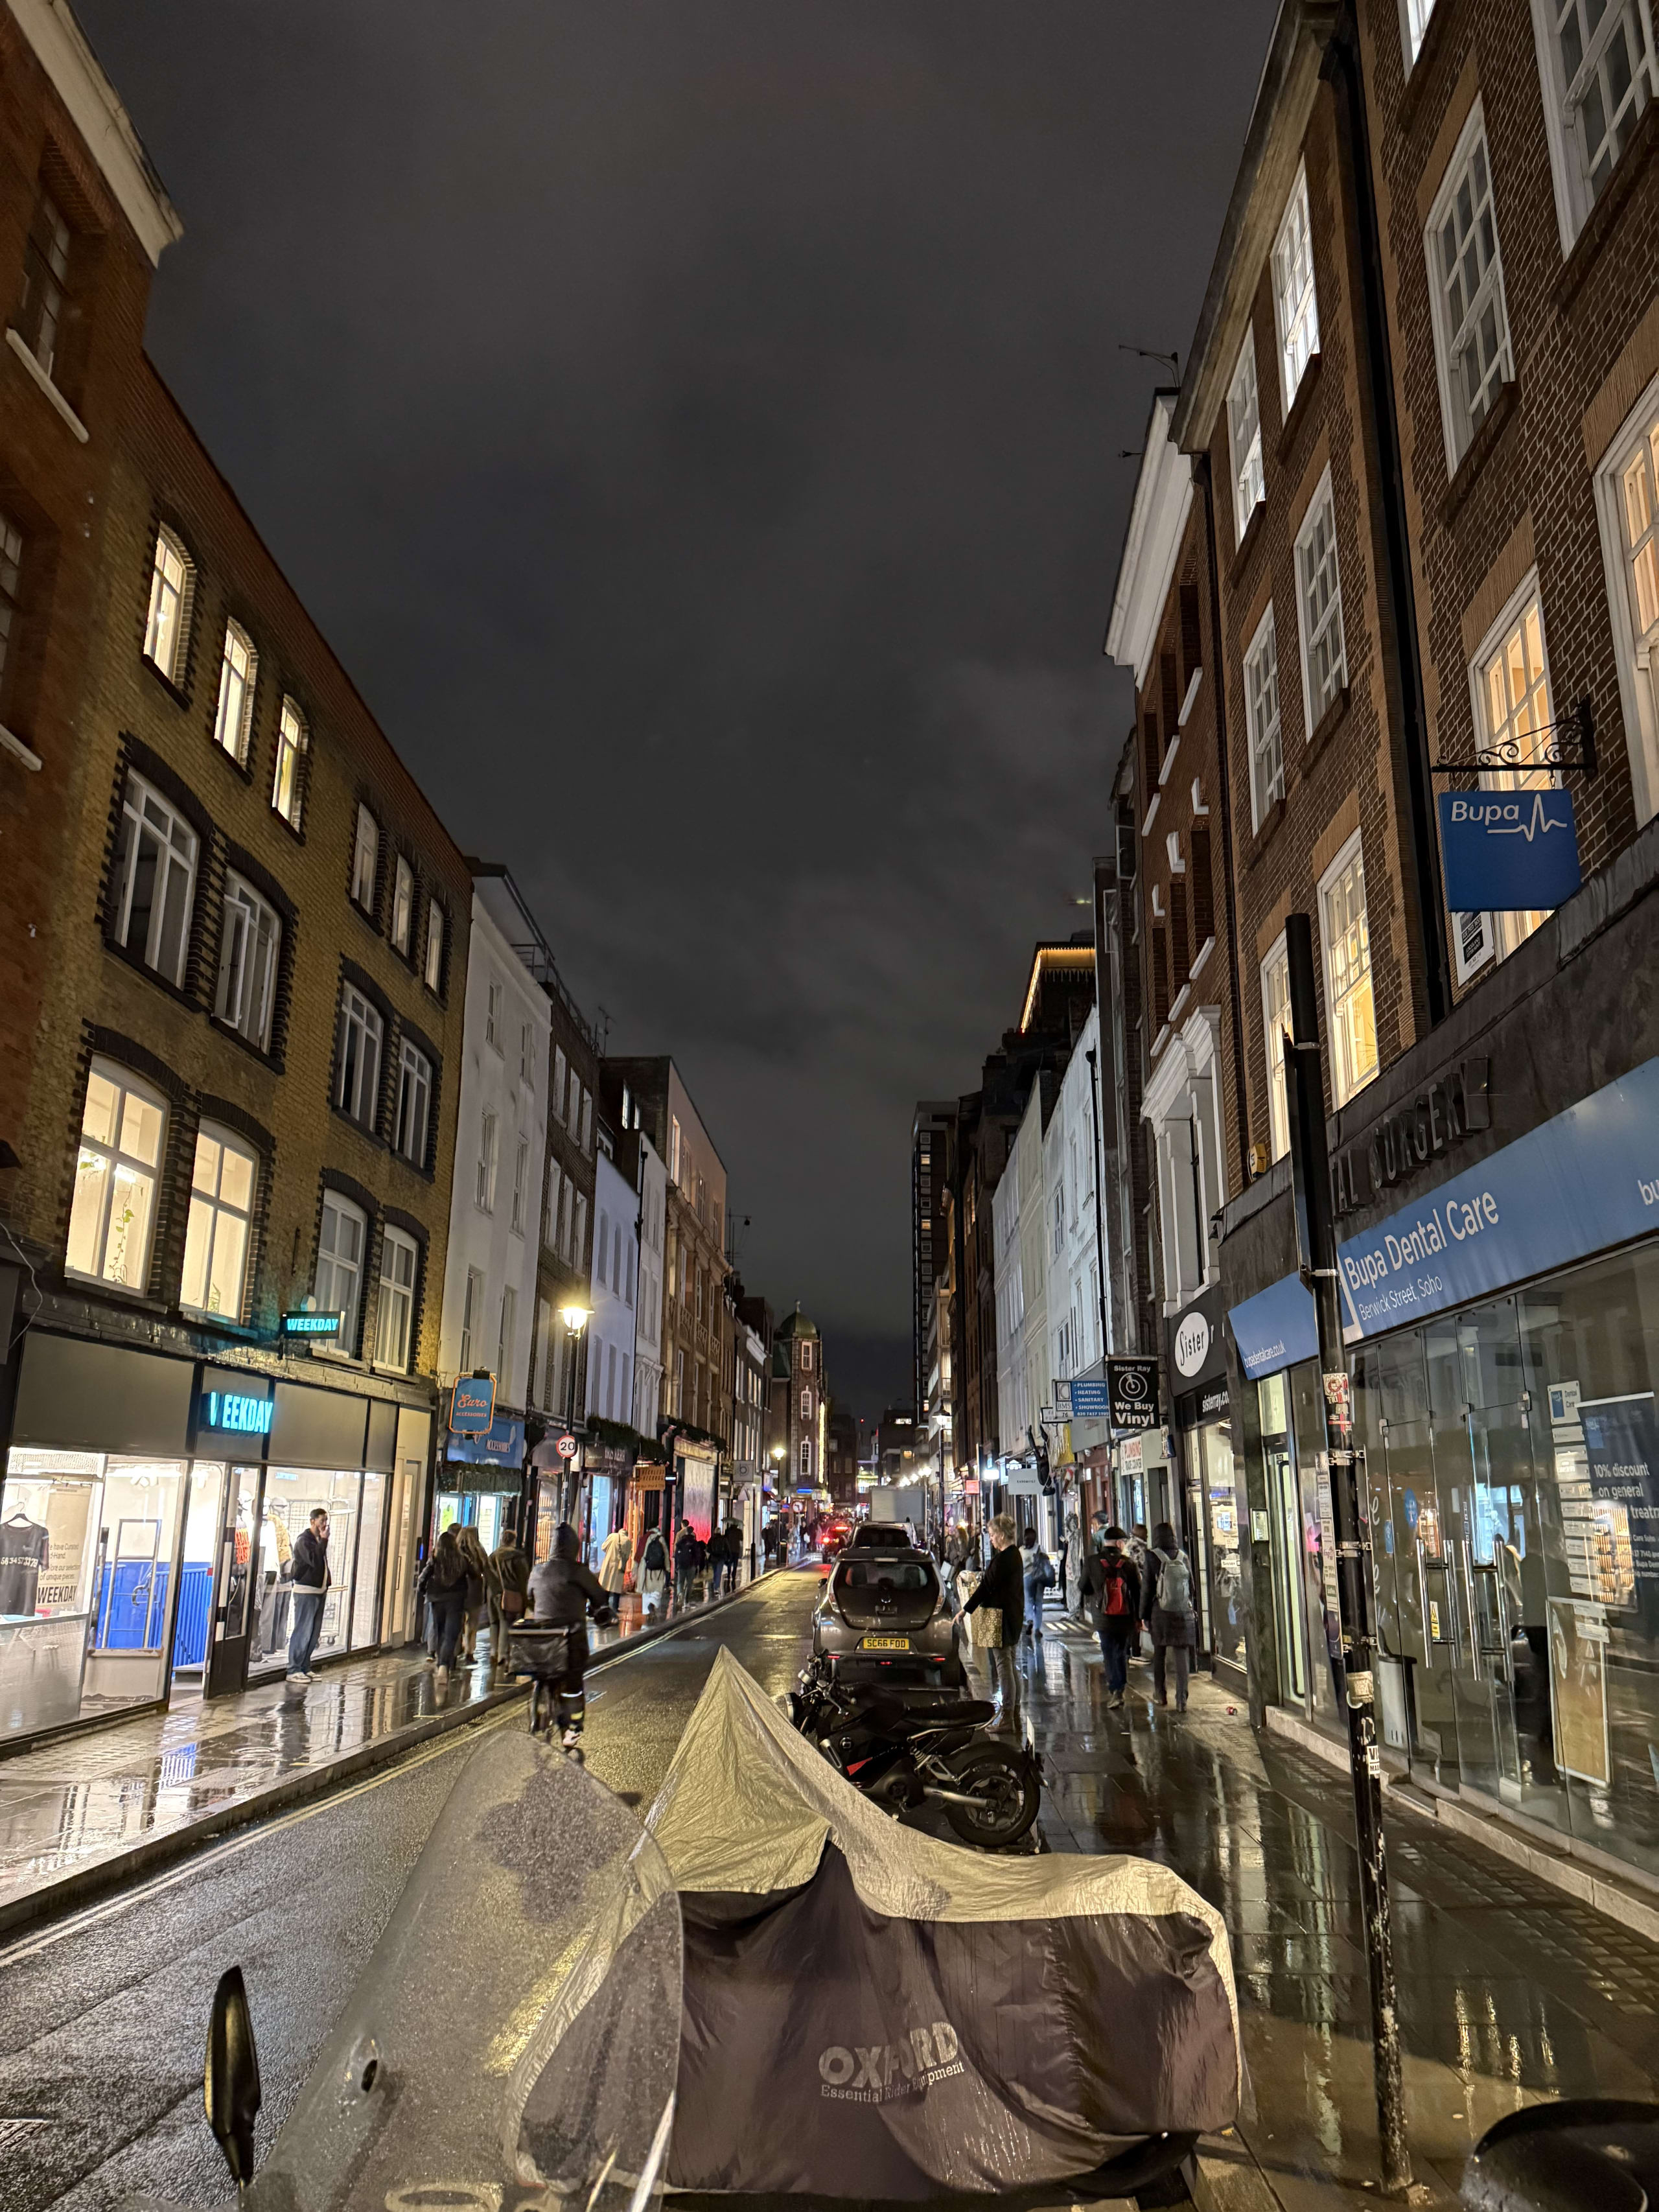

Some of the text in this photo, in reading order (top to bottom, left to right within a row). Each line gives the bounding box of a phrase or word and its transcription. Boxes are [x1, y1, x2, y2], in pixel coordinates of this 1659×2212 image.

[1451, 800, 1519, 826] Bupa
[1344, 1192, 1499, 1290] Bupa Dental Care
[1358, 1274, 1442, 1320] Berwick Street, Soho
[287, 1318, 338, 1331] WEEKDAY
[1179, 1331, 1204, 1366] Sister
[457, 1393, 488, 1408] Euro
[1115, 1401, 1154, 1412] We Buy
[1115, 1412, 1155, 1426] Vinyl
[561, 1441, 575, 1451] 20
[1594, 1462, 1650, 1478] 10% discount
[1598, 1482, 1644, 1500] on general
[38, 1585, 78, 1603] WEEKDAY
[867, 1638, 888, 1647] SC66
[821, 2084, 883, 2103] Essential
